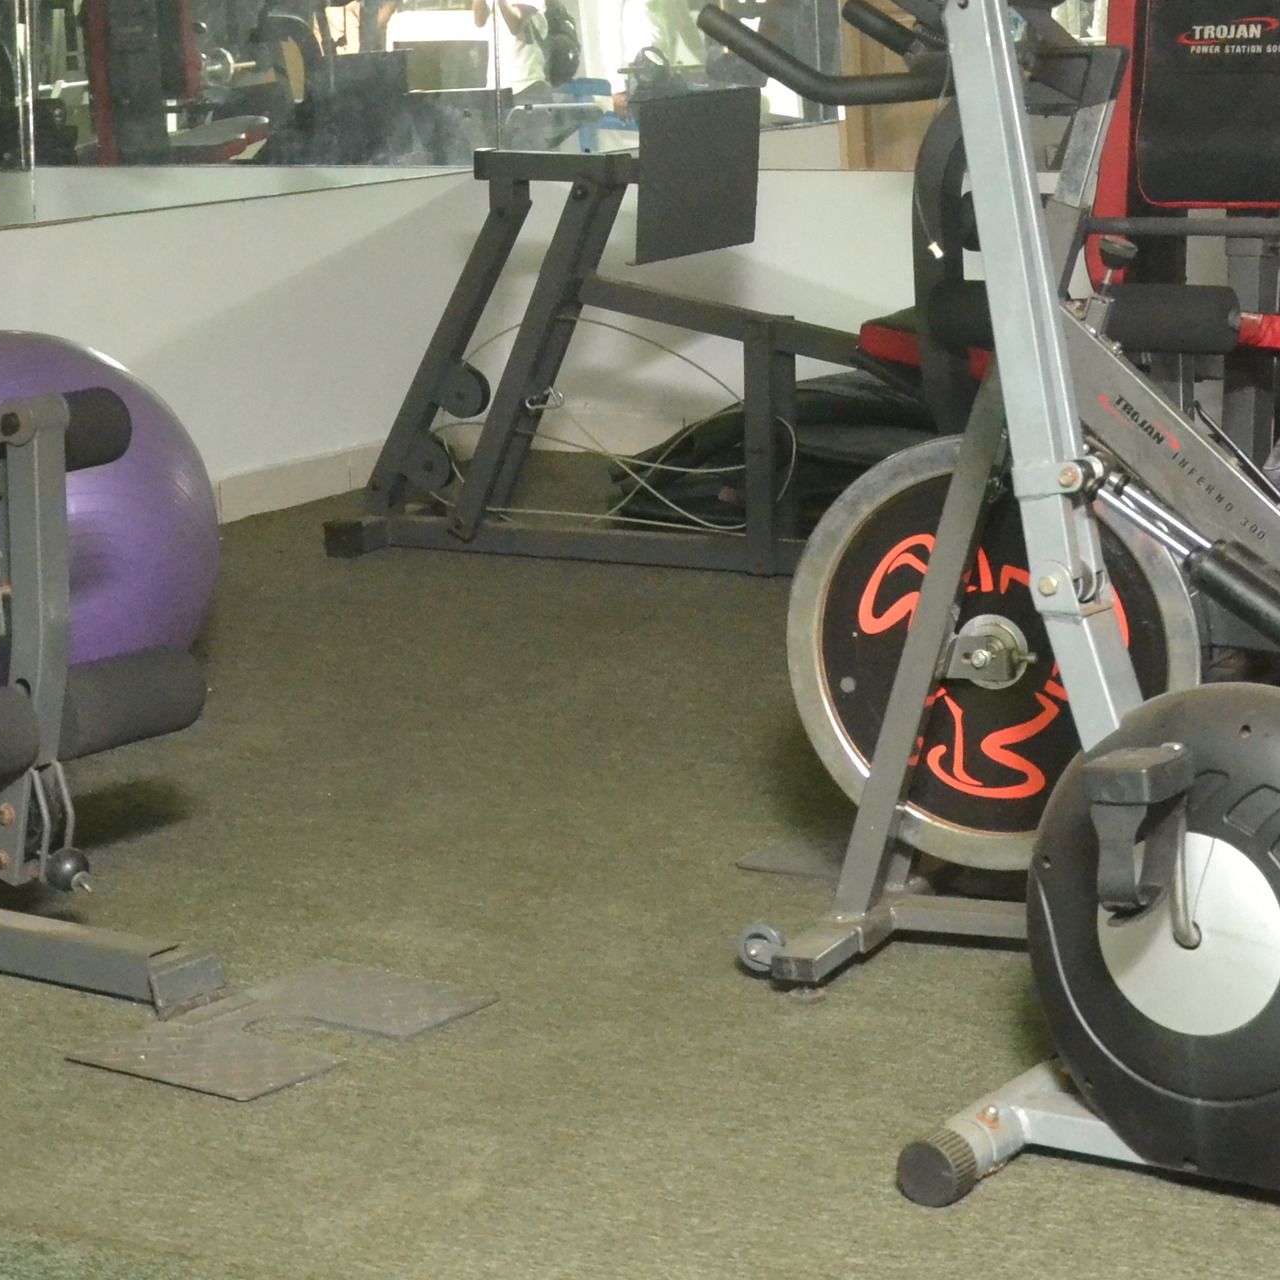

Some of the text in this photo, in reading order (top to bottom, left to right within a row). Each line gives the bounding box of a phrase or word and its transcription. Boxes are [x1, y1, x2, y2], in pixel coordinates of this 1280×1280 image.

[1192, 24, 1262, 40] TROJAN
[1190, 45, 1220, 54] POWER
[1224, 45, 1262, 54] STATION
[1113, 394, 1266, 541] TROJAN INFERNO 300
